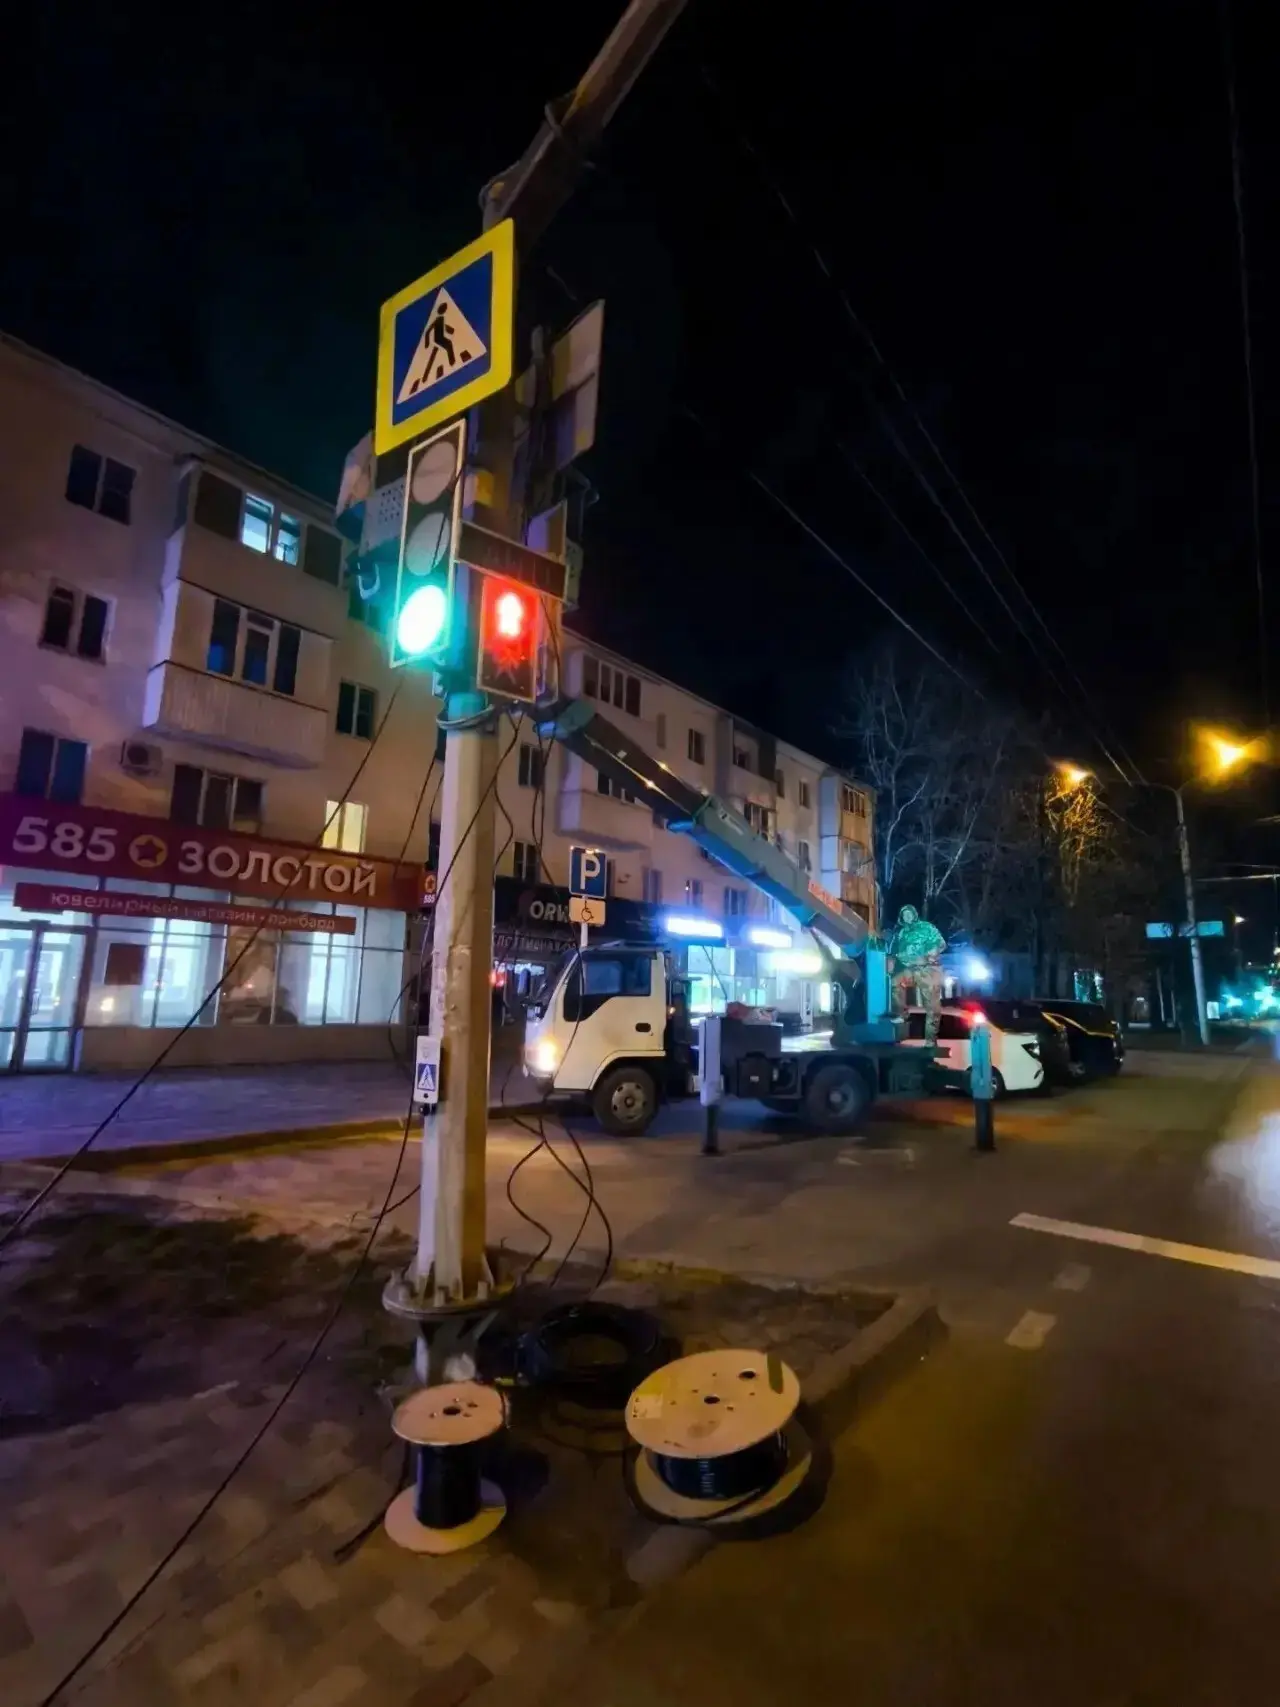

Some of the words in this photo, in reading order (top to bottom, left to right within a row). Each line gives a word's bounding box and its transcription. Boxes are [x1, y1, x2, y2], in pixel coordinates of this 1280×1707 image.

[12, 816, 118, 863] 585
[178, 840, 376, 897] ЗОЛОТОЙ
[580, 852, 601, 890] P
[52, 893, 180, 915] ювелирный
